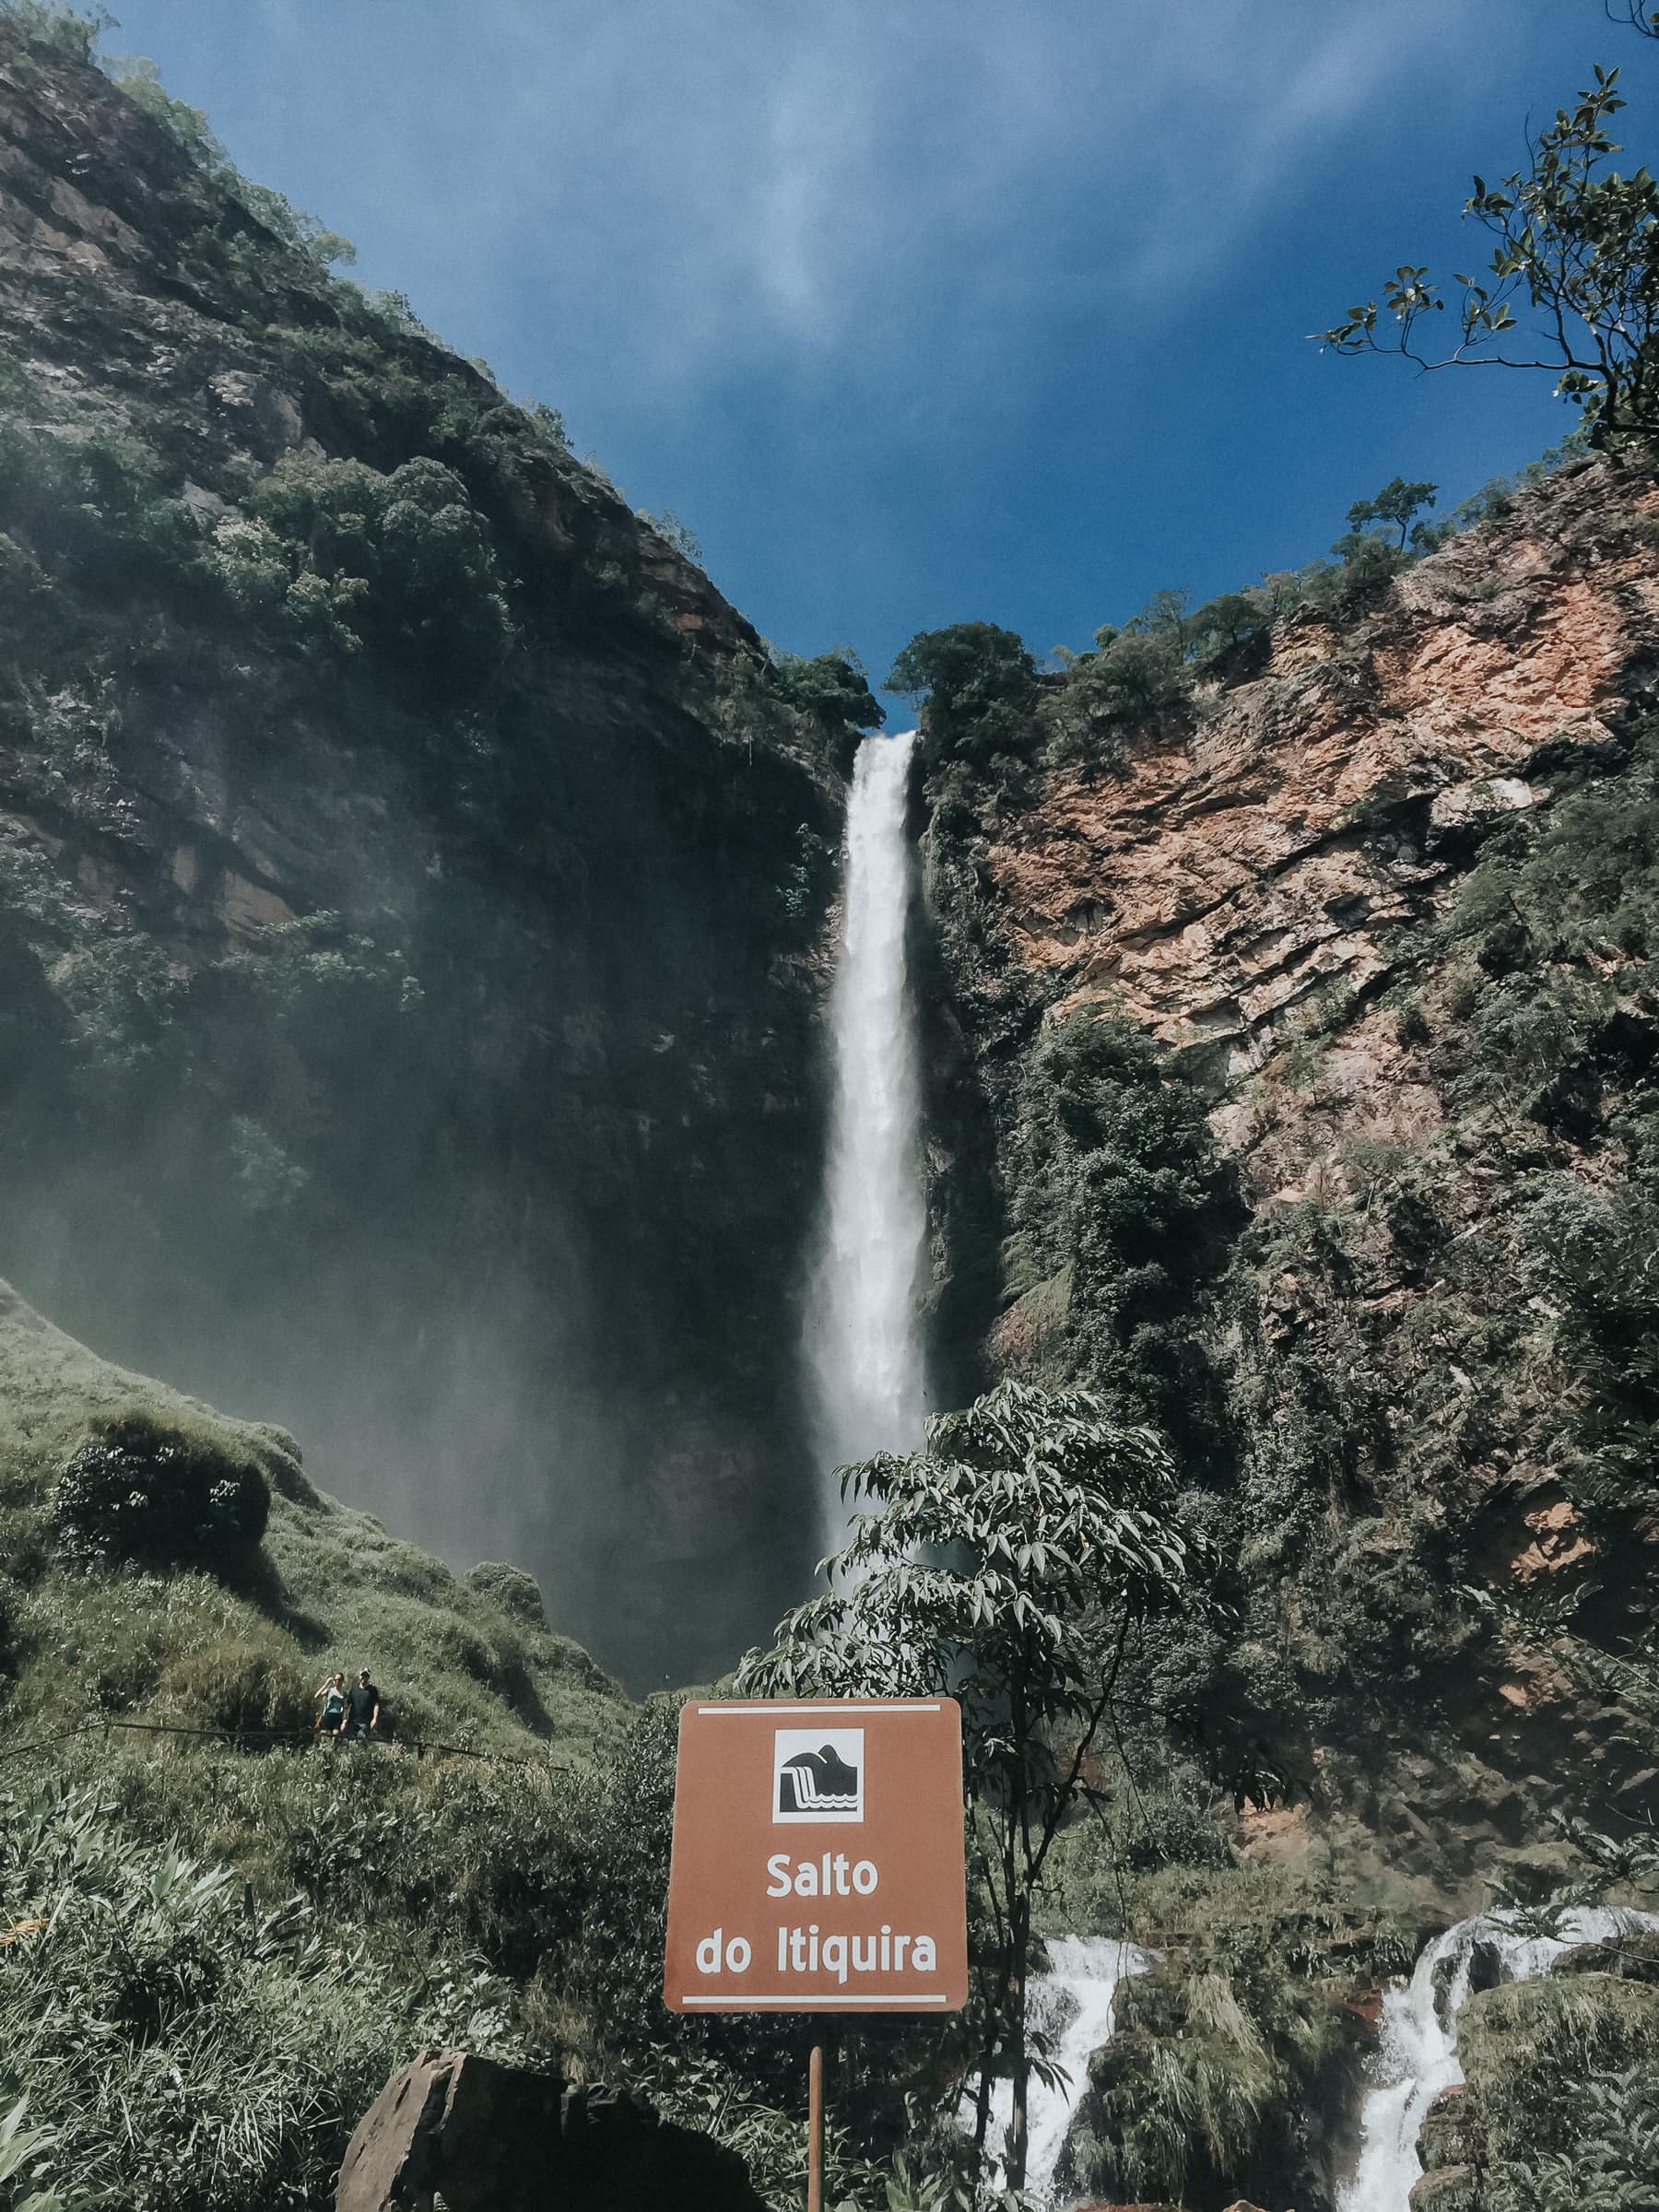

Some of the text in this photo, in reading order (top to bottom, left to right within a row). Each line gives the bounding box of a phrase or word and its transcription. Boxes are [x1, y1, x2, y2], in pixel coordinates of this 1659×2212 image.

[766, 1852, 878, 1898] Salto
[696, 1924, 936, 1984] do Itiquira
